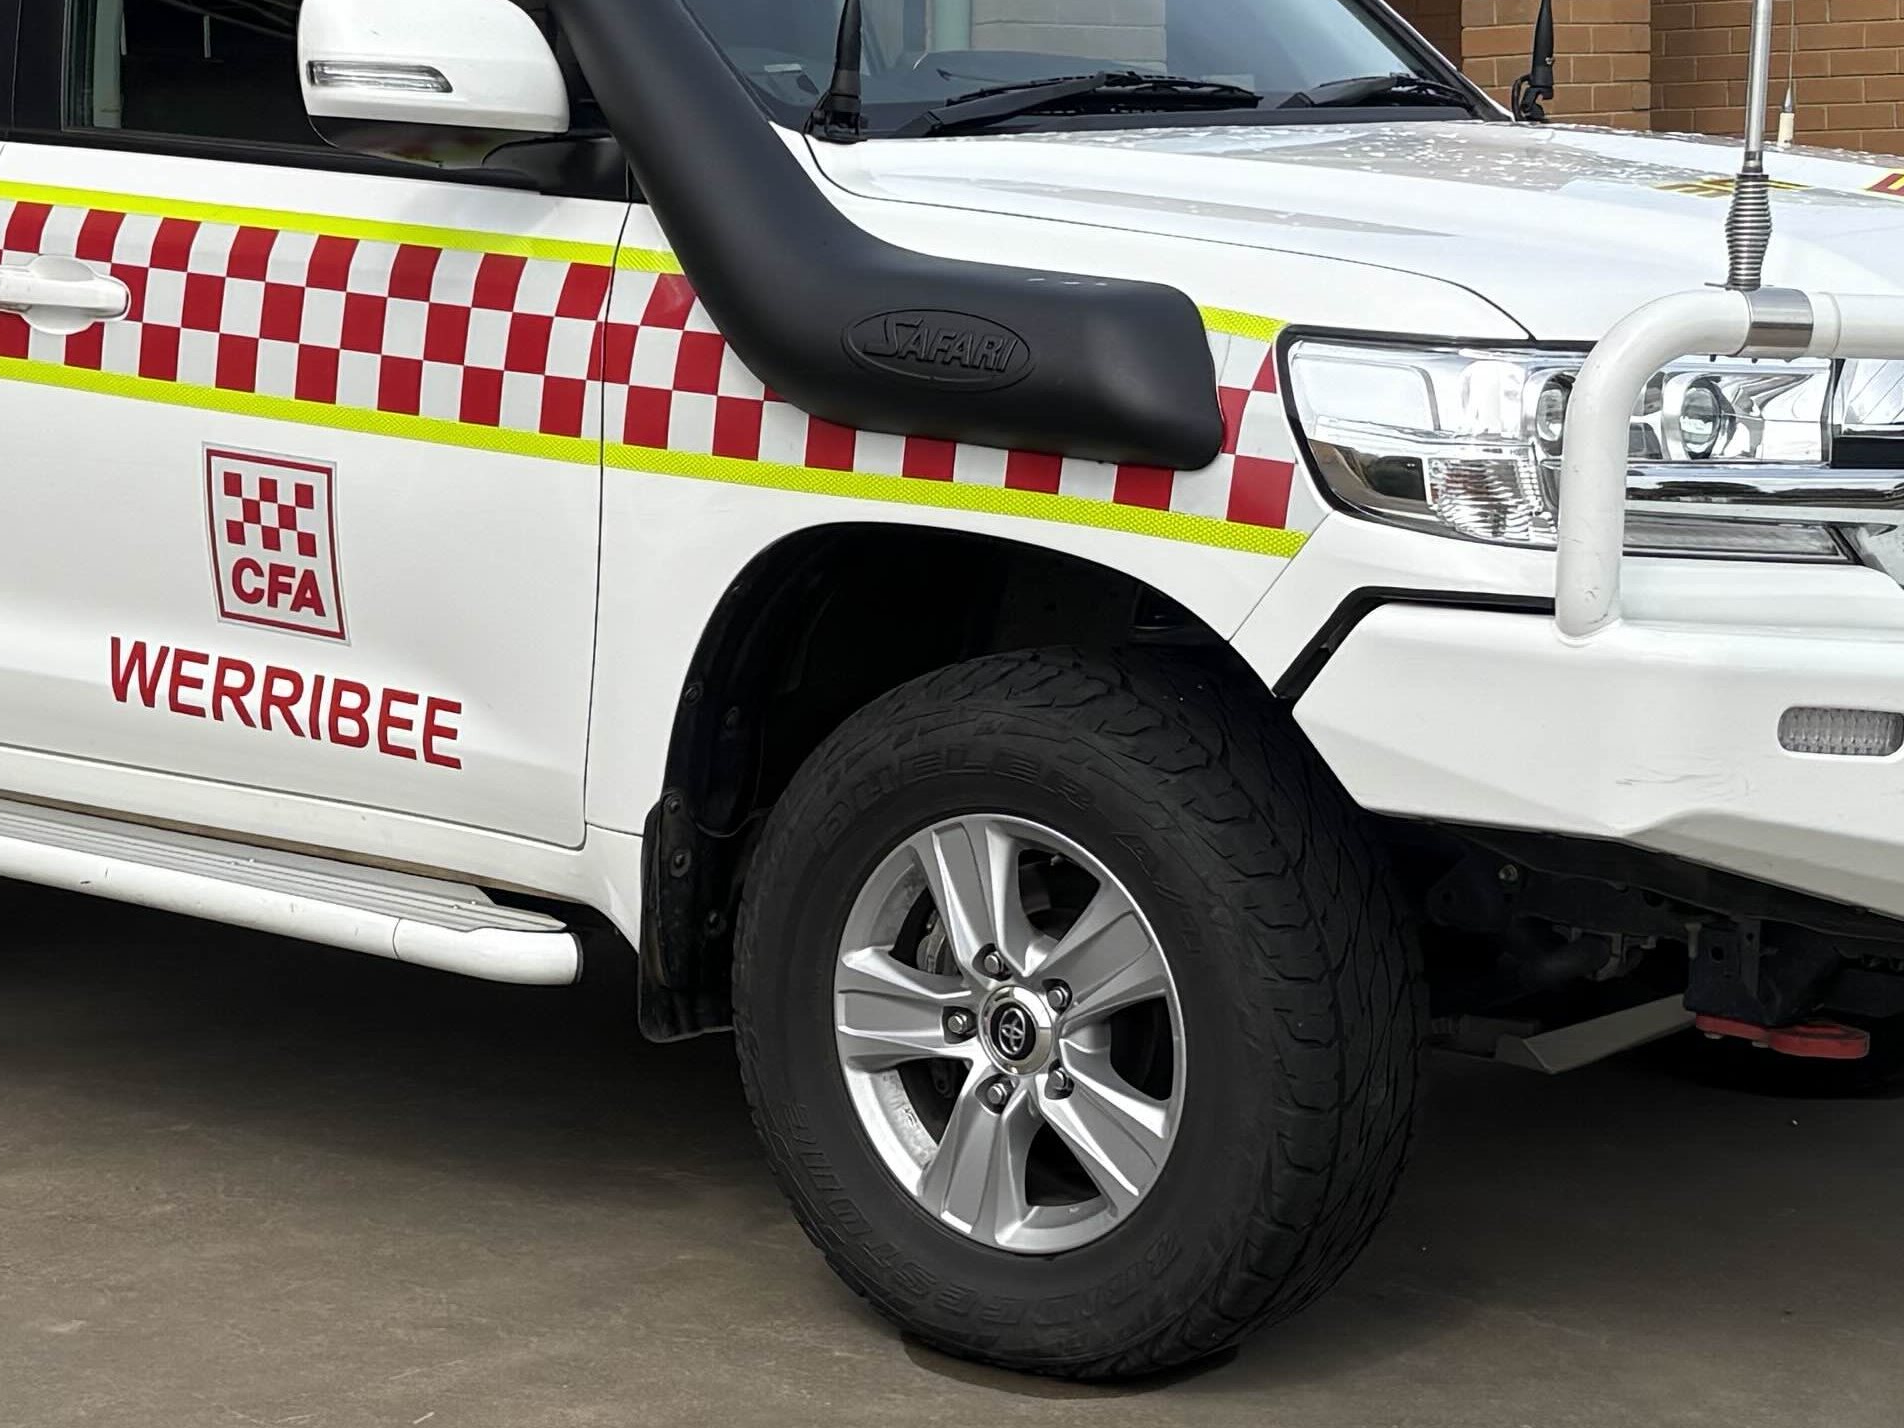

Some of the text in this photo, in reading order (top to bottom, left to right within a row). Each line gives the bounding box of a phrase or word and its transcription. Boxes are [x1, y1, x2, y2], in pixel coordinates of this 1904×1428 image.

[862, 316, 1018, 373] SAFARI
[230, 556, 327, 619] CFA
[109, 636, 463, 771] WERRIBEE
